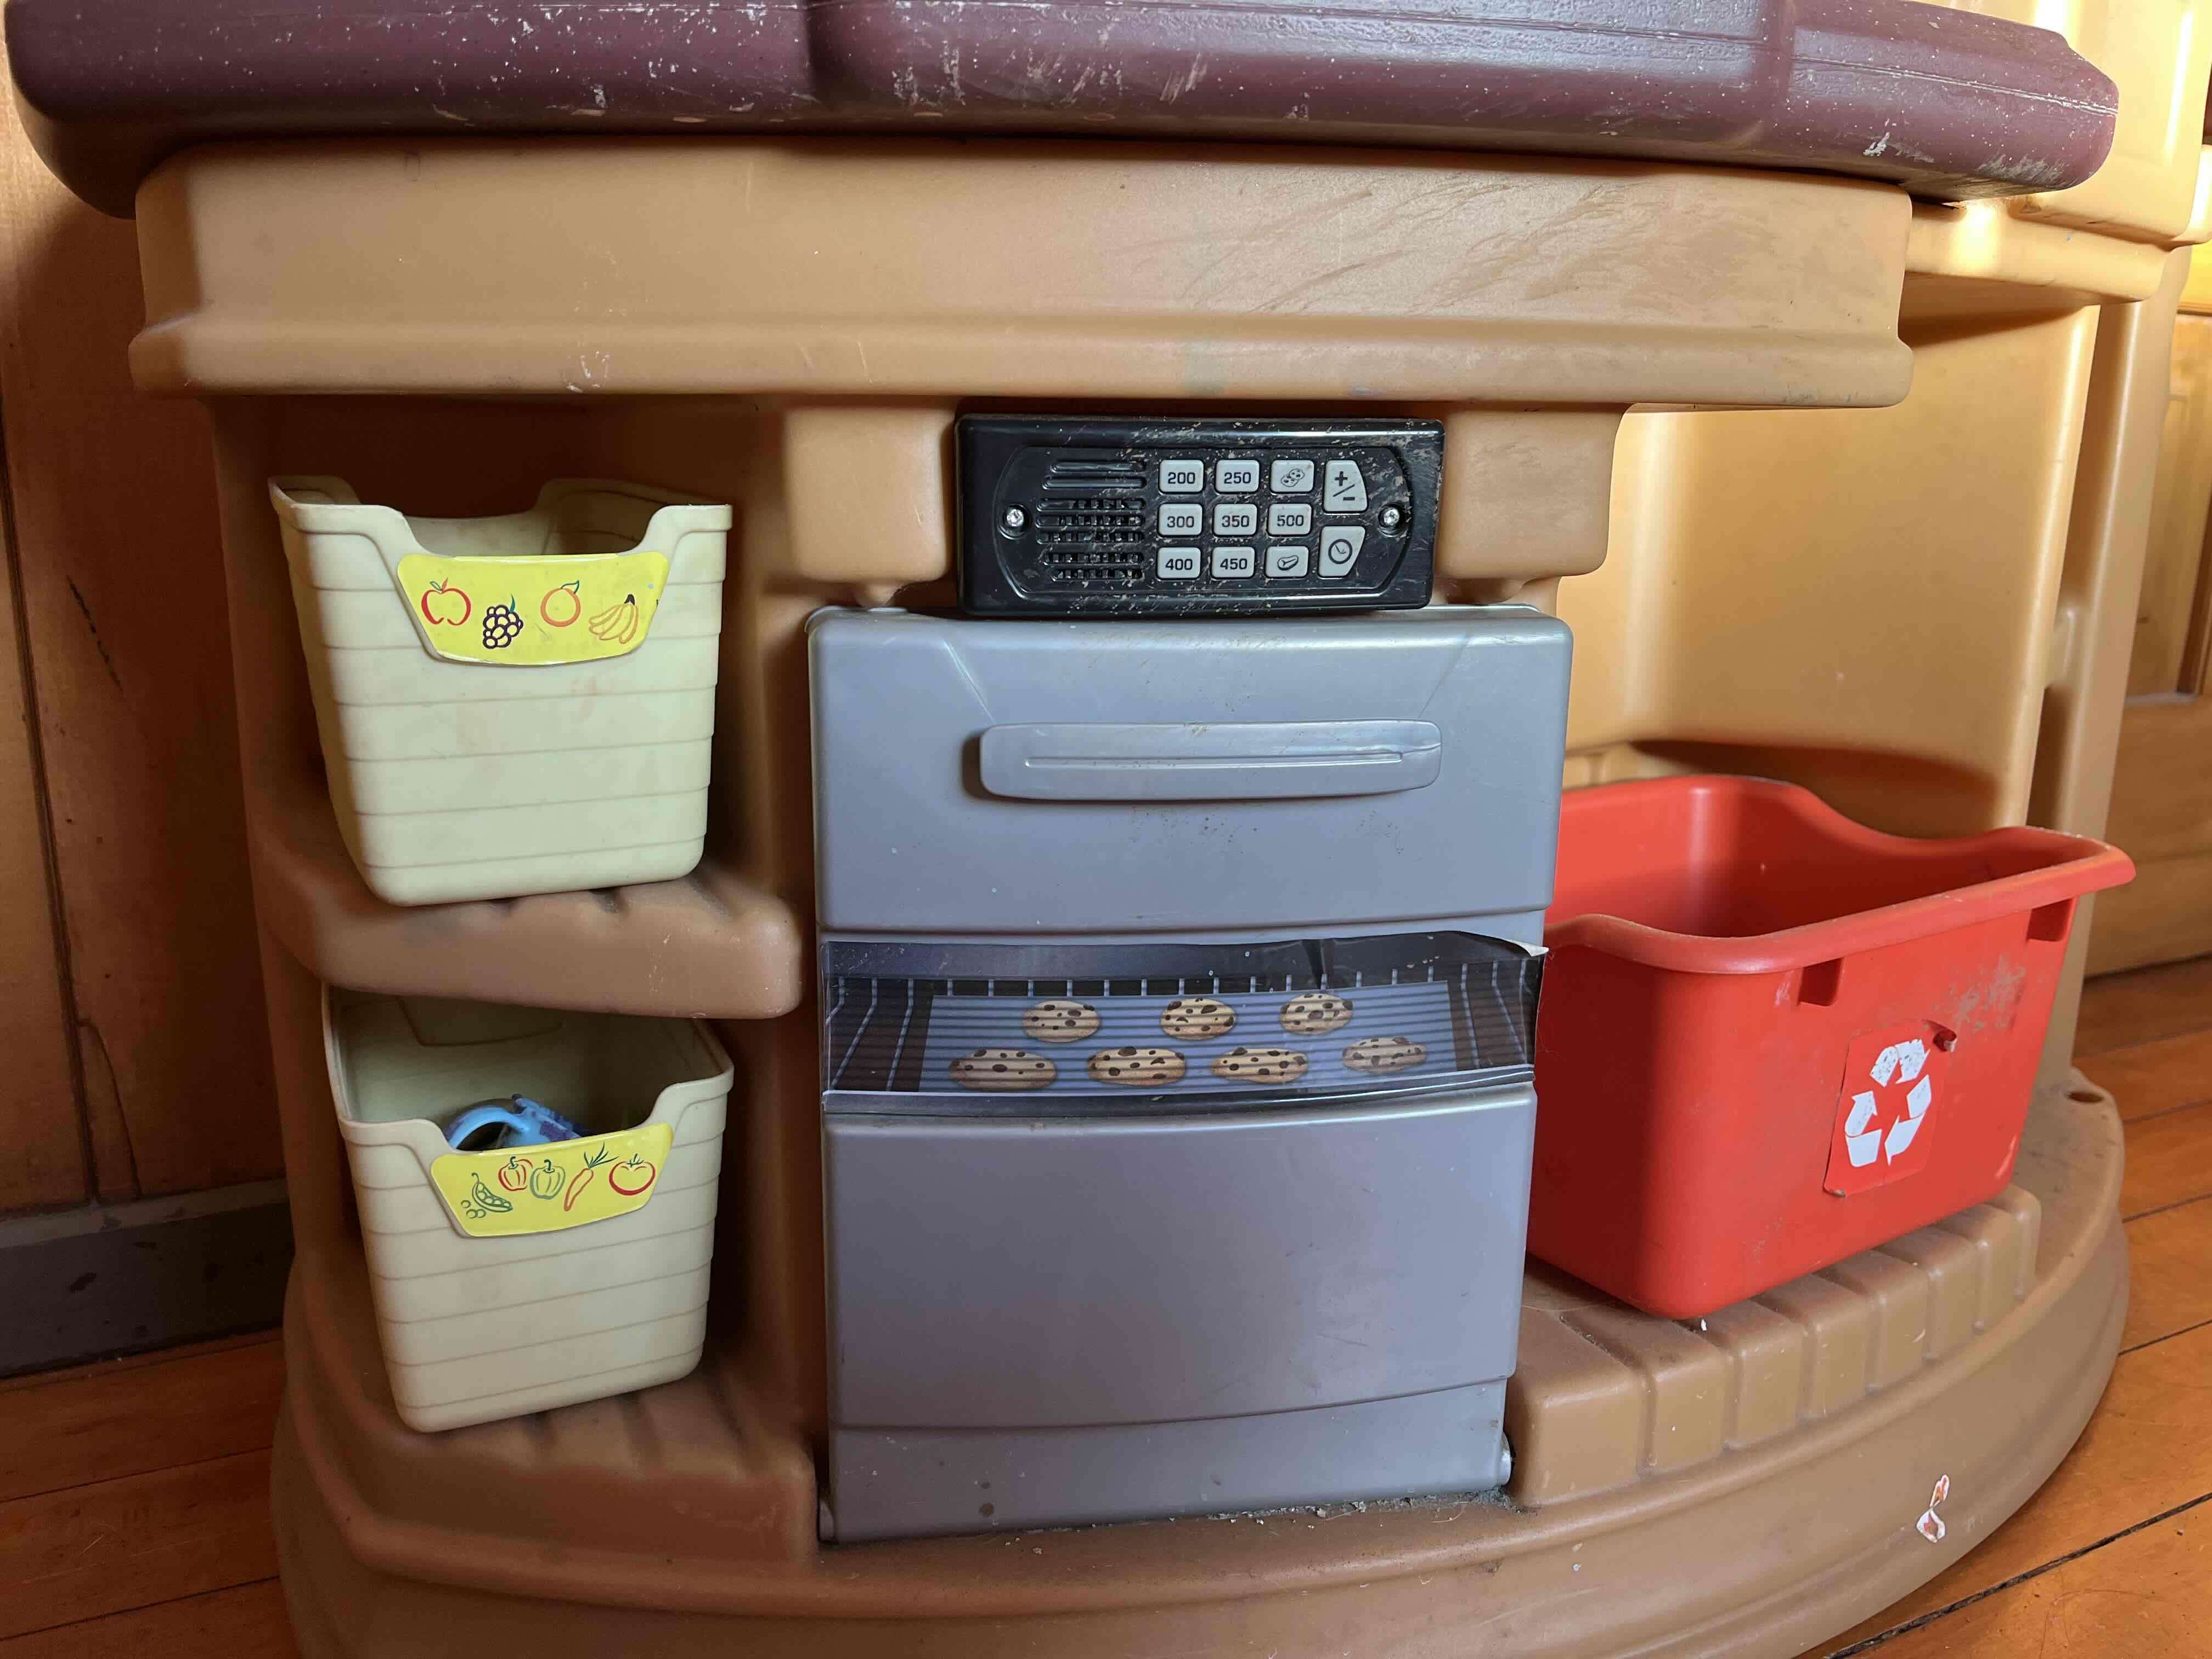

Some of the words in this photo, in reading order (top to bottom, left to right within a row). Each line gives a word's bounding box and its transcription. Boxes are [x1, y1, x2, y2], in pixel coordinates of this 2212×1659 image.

[1167, 472, 1195, 484] 200
[1223, 472, 1251, 484] 250
[1167, 516, 1195, 528] 300
[1221, 515, 1250, 527] 350
[1277, 515, 1304, 527] 500
[1165, 558, 1193, 570] 400
[1220, 558, 1248, 570] 450
